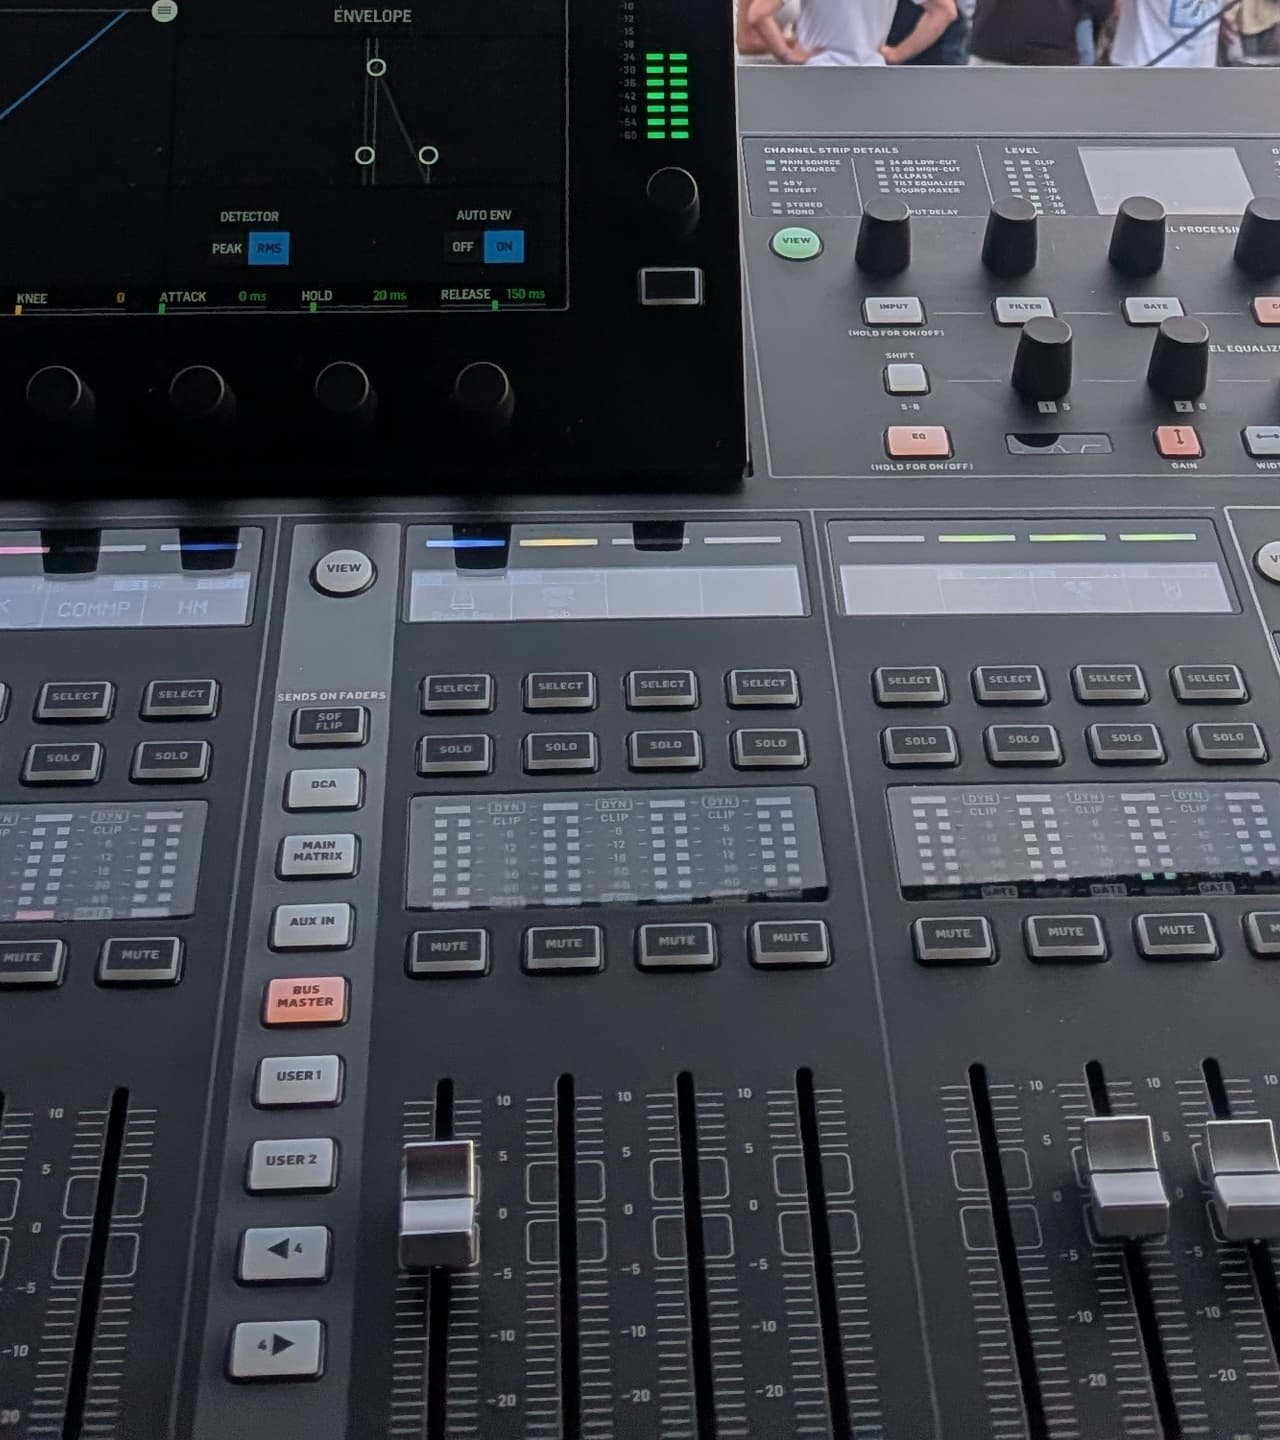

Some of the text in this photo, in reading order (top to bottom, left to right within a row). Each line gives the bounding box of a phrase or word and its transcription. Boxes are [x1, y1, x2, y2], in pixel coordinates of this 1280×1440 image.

[334, 8, 412, 24] ENVELOPE
[220, 210, 280, 223] DETECTOR
[456, 210, 512, 222] AUTO ENV
[212, 242, 282, 254] PEAK RMS
[452, 241, 513, 252] OFF ON
[302, 290, 408, 302] HOLD 20 ms
[440, 288, 546, 300] RELEASE 150 ms
[326, 563, 361, 573] VIEW
[57, 601, 131, 618] COMMP
[178, 600, 208, 615] HM
[434, 684, 480, 693] SELECT
[277, 691, 386, 701] SENDS ON FADERS
[318, 712, 343, 721] SOF
[316, 721, 343, 730] FLIP
[440, 745, 472, 754] SOLO
[311, 779, 337, 789] DCA
[302, 841, 336, 850] MAIN
[293, 851, 343, 861] MATRIX
[289, 916, 335, 926] AUX IN
[431, 941, 469, 951] MUTE
[293, 985, 320, 995] BUS
[277, 996, 334, 1008] MASTER
[266, 1154, 317, 1166] USER 2
